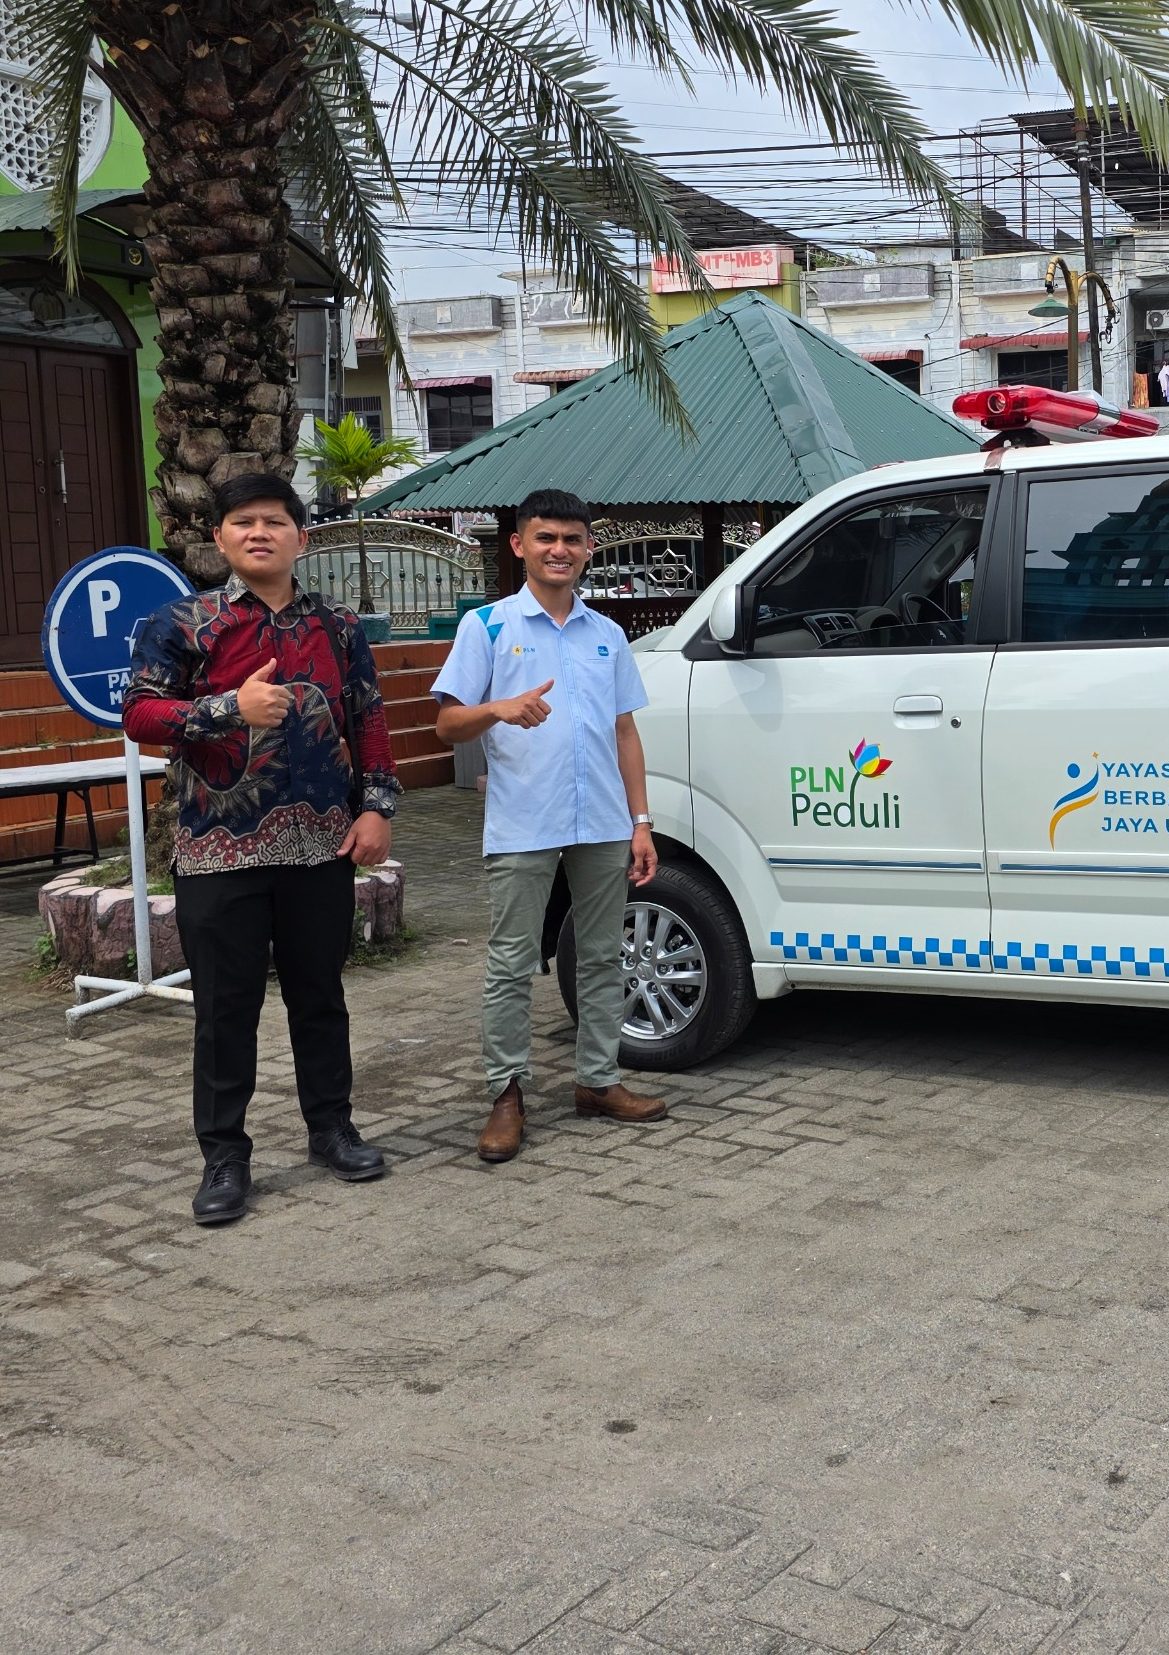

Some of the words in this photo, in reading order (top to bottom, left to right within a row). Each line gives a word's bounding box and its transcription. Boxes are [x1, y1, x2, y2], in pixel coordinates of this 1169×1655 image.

[87, 579, 121, 638] P
[790, 766, 845, 793] PLN
[791, 791, 900, 829] Peduli
[1101, 817, 1159, 833] JAYA
